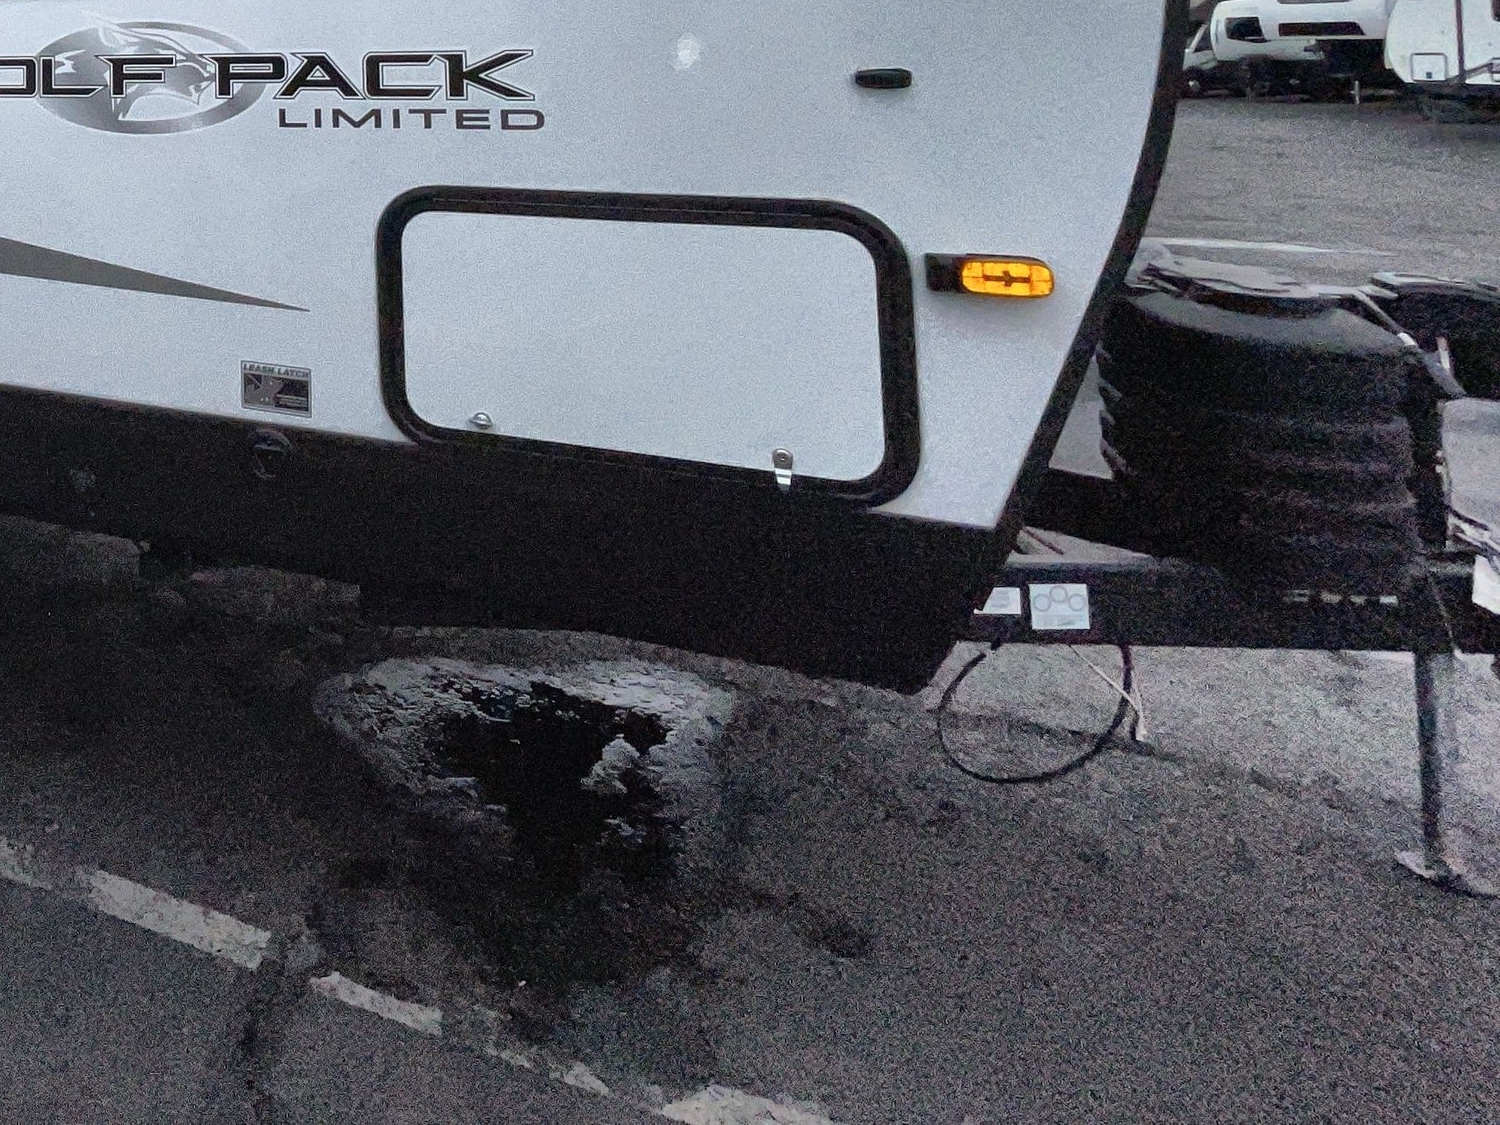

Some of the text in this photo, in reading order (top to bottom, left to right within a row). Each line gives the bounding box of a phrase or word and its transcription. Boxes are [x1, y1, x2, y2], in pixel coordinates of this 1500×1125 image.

[199, 49, 535, 101] PACK
[278, 107, 546, 131] LIMITED
[243, 363, 309, 379] LEASH LATCH
